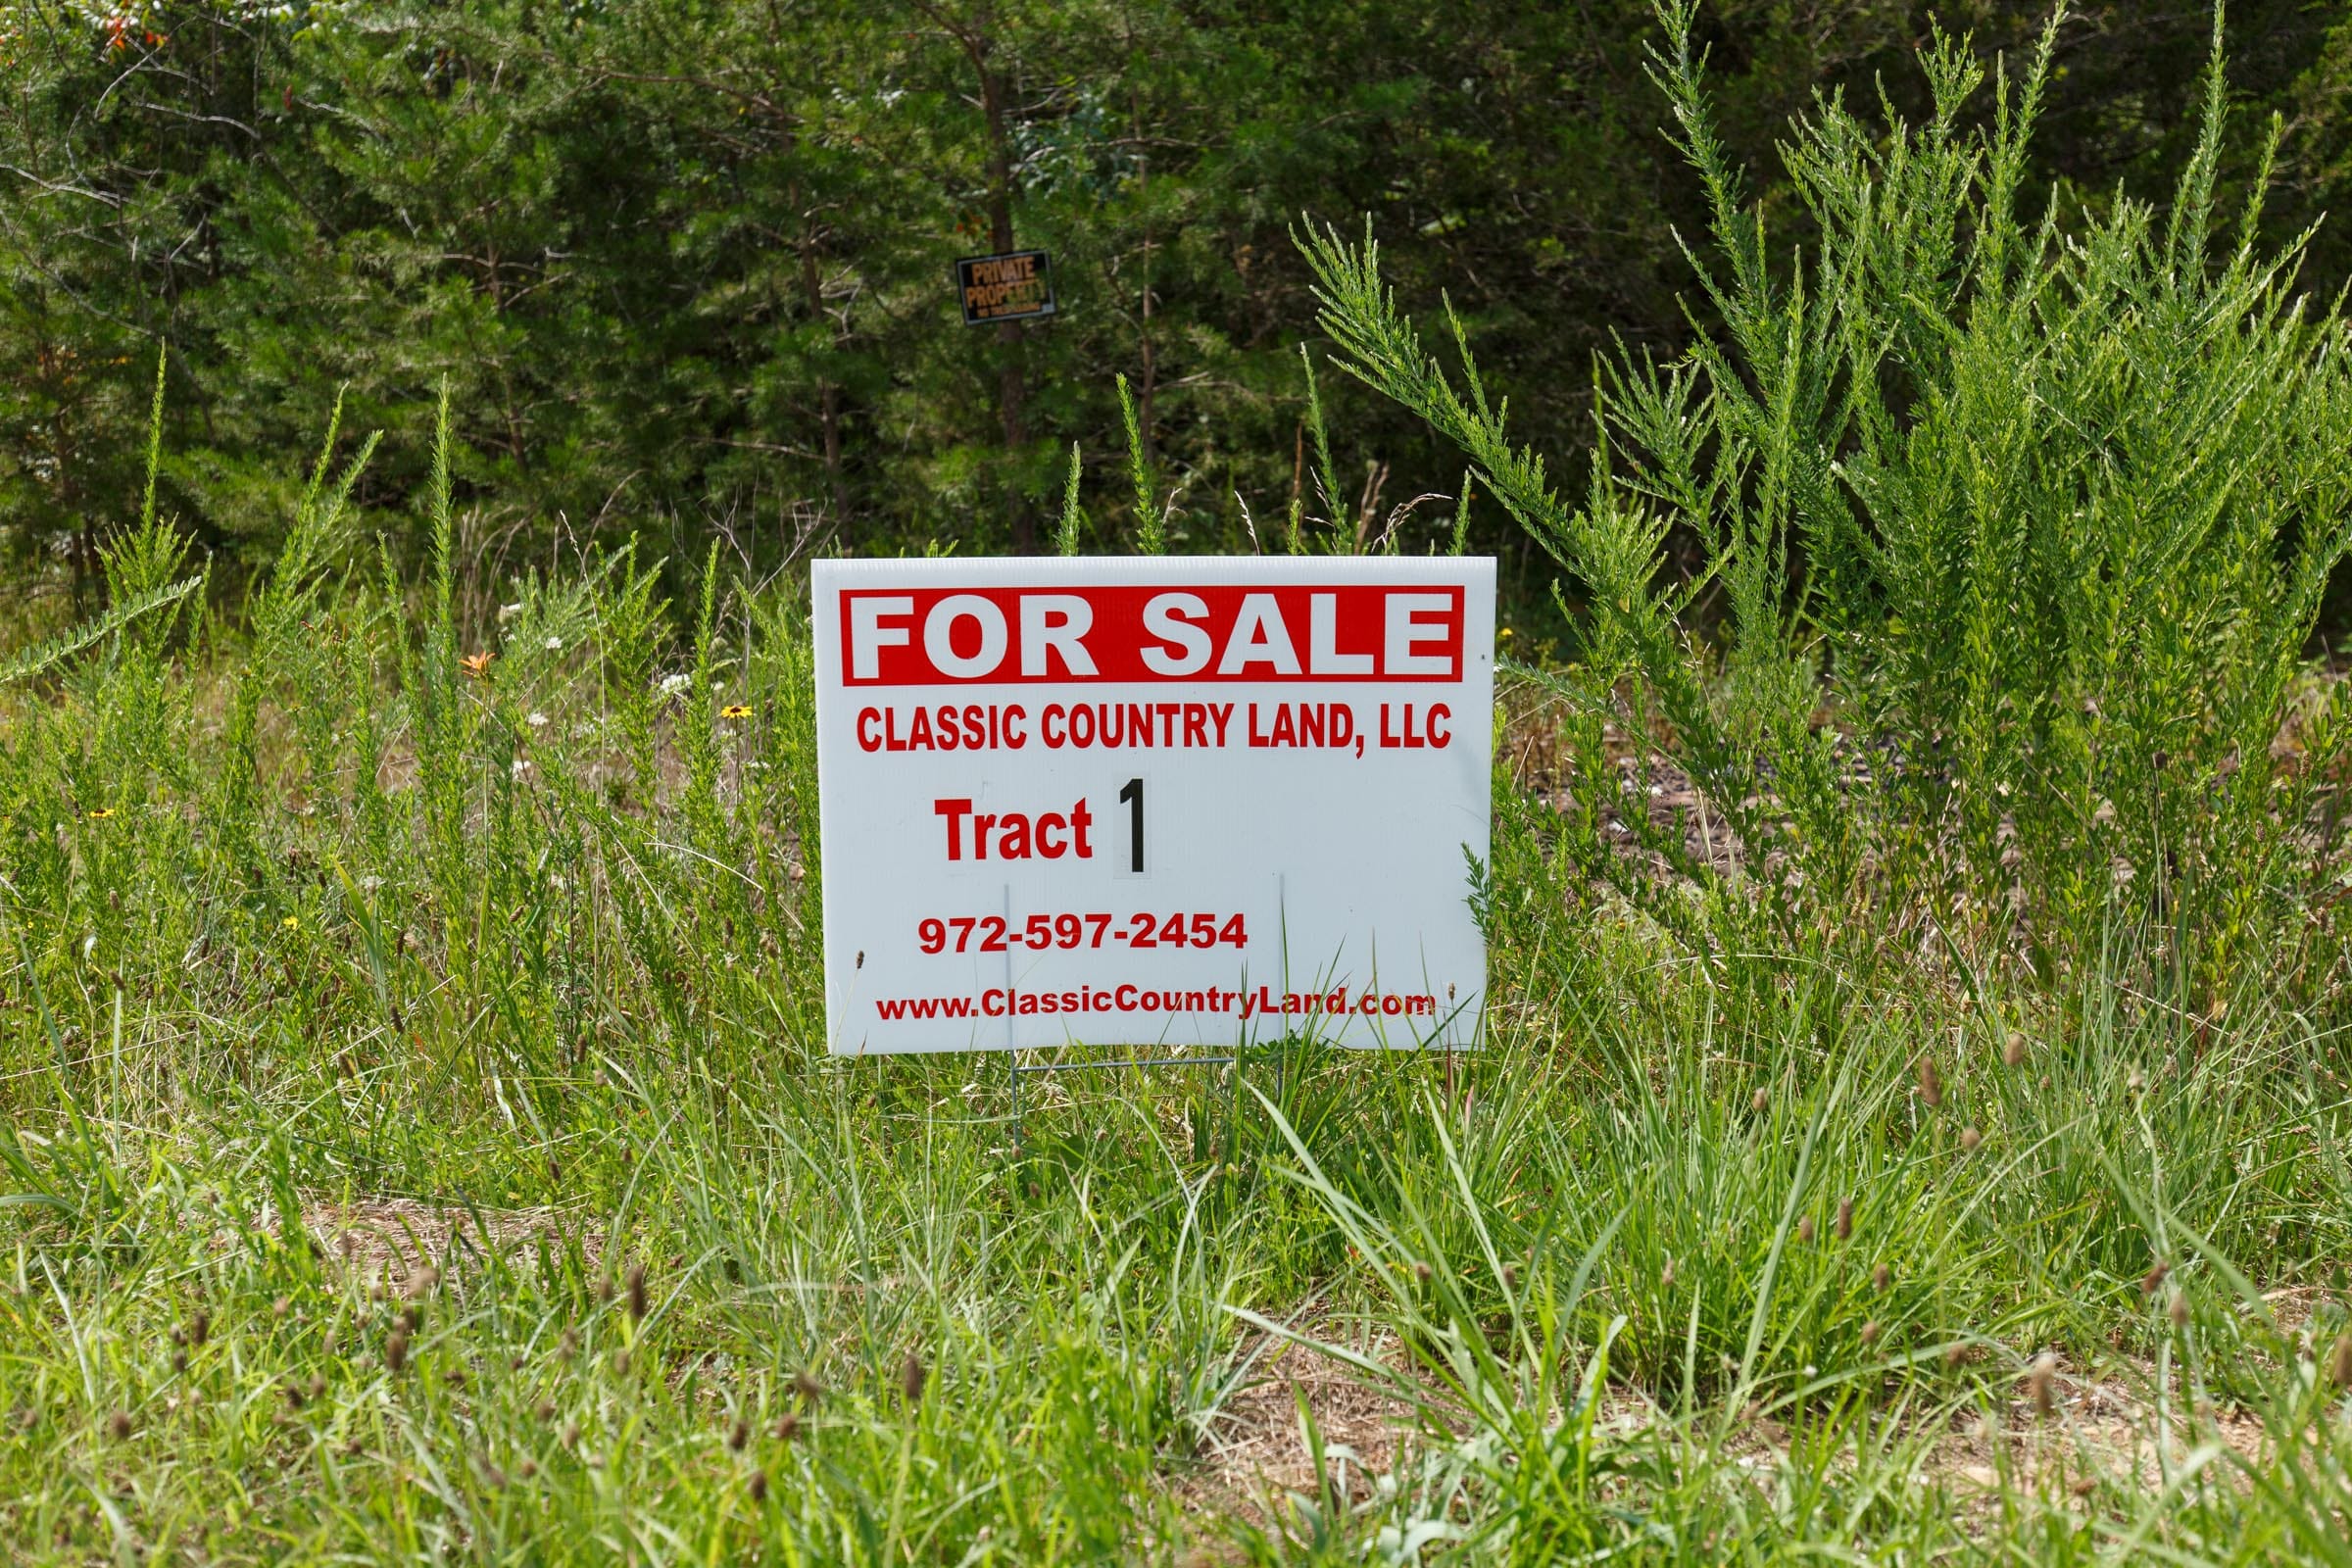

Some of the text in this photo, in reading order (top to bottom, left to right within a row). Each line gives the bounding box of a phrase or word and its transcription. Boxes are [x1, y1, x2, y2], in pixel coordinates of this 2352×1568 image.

[971, 256, 1035, 285] PRIVATE
[851, 592, 1452, 679] FOR SALE
[857, 703, 1451, 760] CLASSIC COUNTRY LAND, LLC
[934, 778, 1145, 873] Tract 1
[918, 912, 1249, 956] 972-597-2454
[877, 984, 1436, 1021] www.ClassicCountryLand.com
